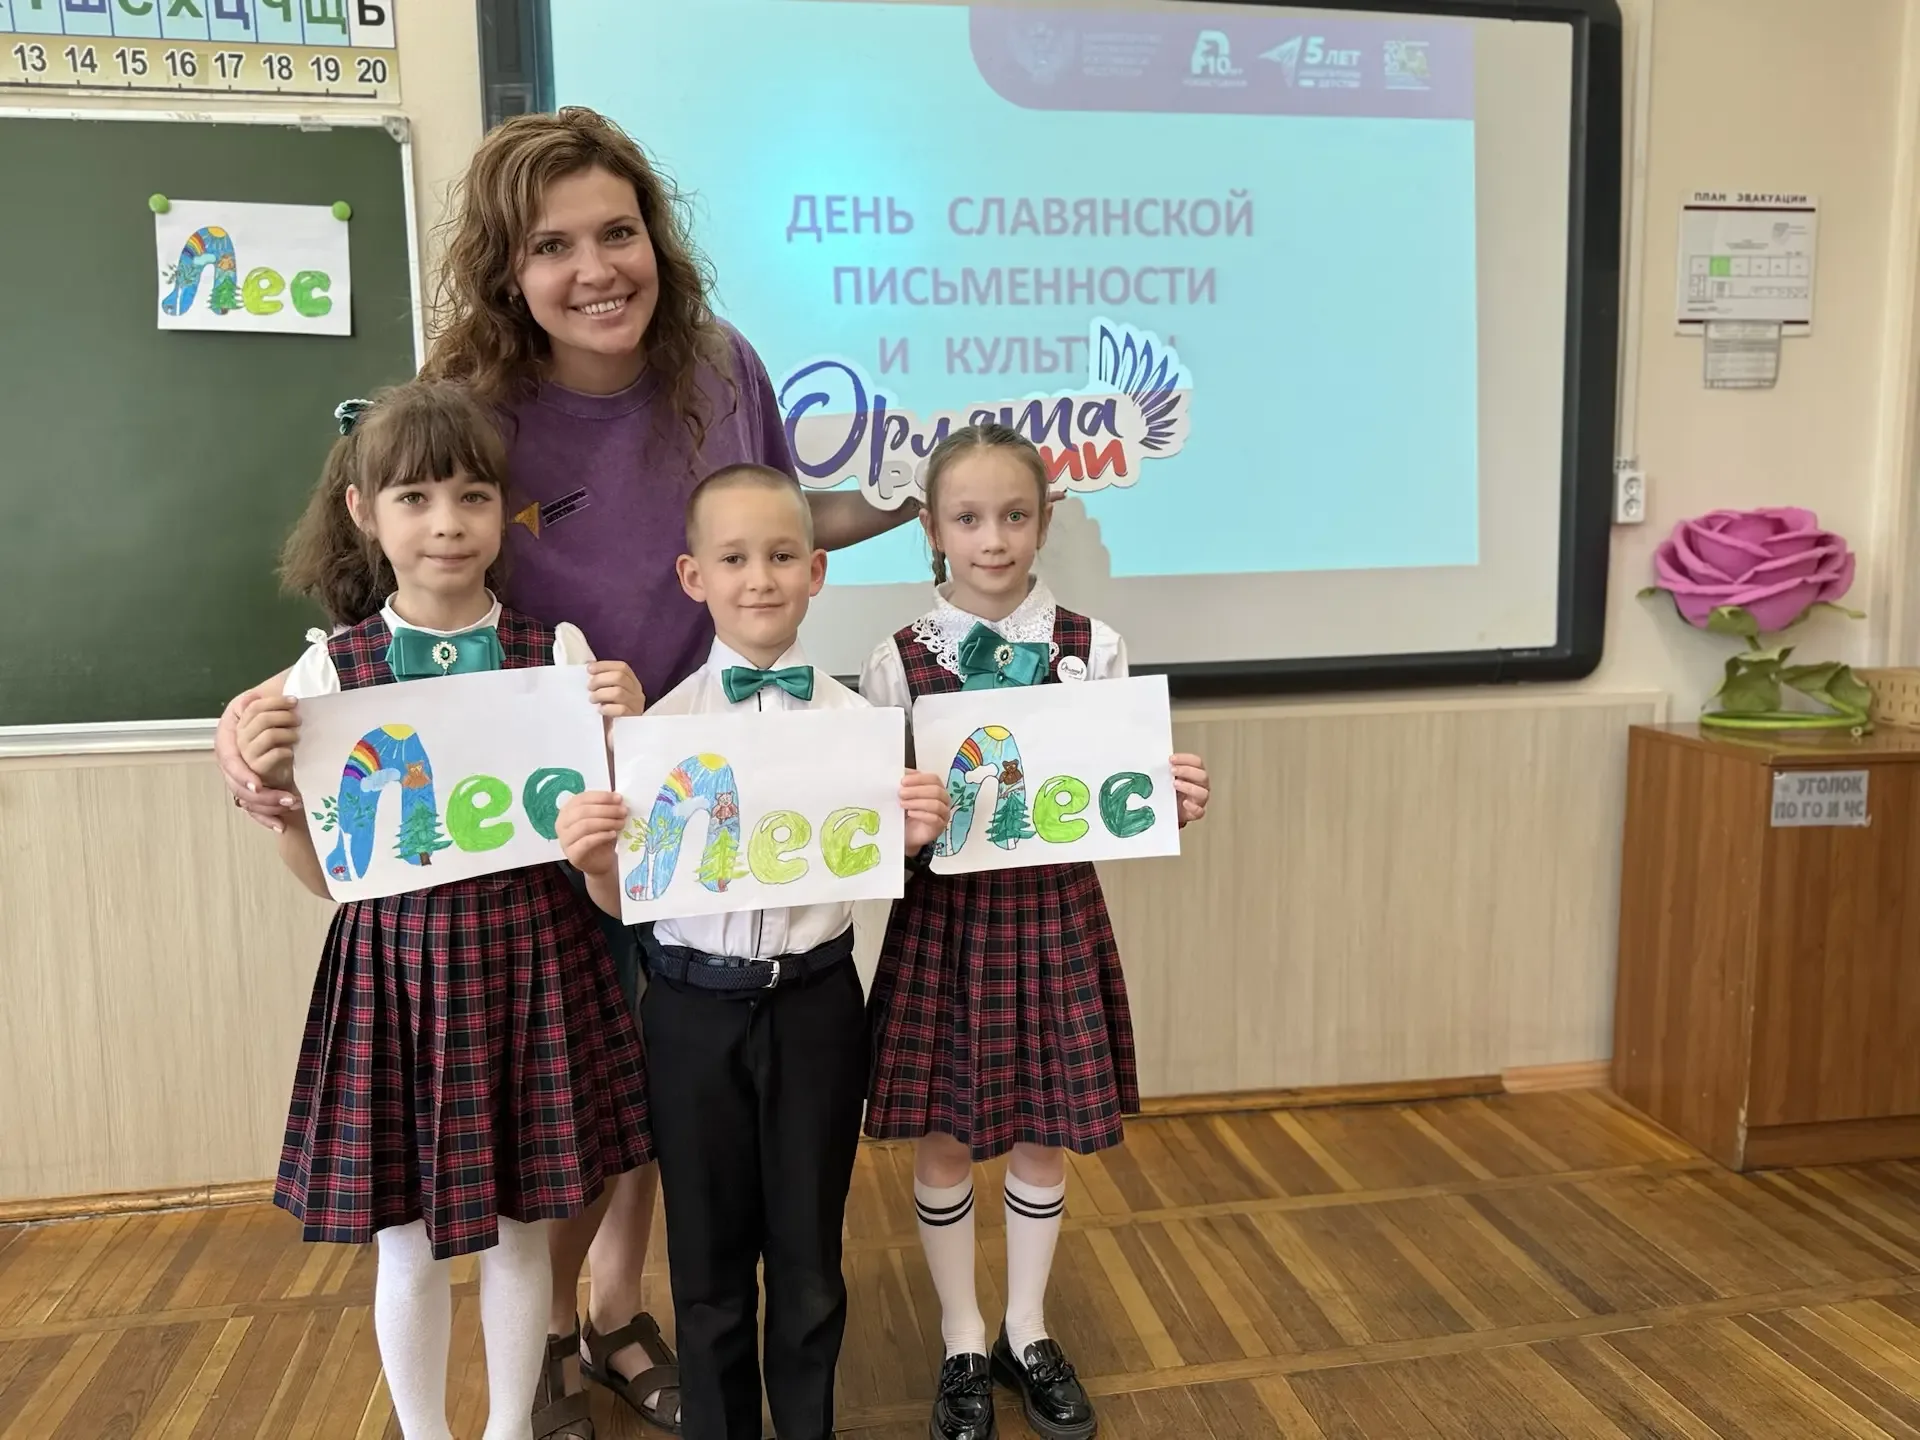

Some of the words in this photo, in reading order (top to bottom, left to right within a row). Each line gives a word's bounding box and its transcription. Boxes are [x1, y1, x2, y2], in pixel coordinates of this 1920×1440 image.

[214, 0, 250, 31] Ц
[262, 0, 292, 23] Ч
[305, 0, 348, 35] Щ
[13, 44, 48, 73] 13
[64, 46, 99, 74] 14
[114, 48, 149, 76] 15
[164, 50, 198, 78] 16
[213, 52, 244, 80] 17
[262, 54, 293, 81] 18
[309, 56, 341, 83] 19
[357, 58, 387, 84] 20
[1304, 36, 1325, 64] 5
[1325, 49, 1361, 66] ЛЕТ
[786, 194, 914, 243] ДЕНЬ
[947, 188, 1255, 238] СЛАВЯНСКОЙ
[1694, 192, 1727, 202] ПЛАН
[1737, 192, 1808, 204] ЭВАКУАЦИИ
[161, 226, 333, 318] Лес
[832, 265, 1218, 306] ПИСЬМЕННОСТИ
[878, 336, 910, 374] И
[932, 724, 1156, 858] Лес
[1796, 776, 1864, 796] УГОЛОК
[624, 752, 881, 901] Лес
[1774, 801, 1798, 819] ПО
[1801, 801, 1823, 819] ГО
[1844, 800, 1865, 818] ЧС
